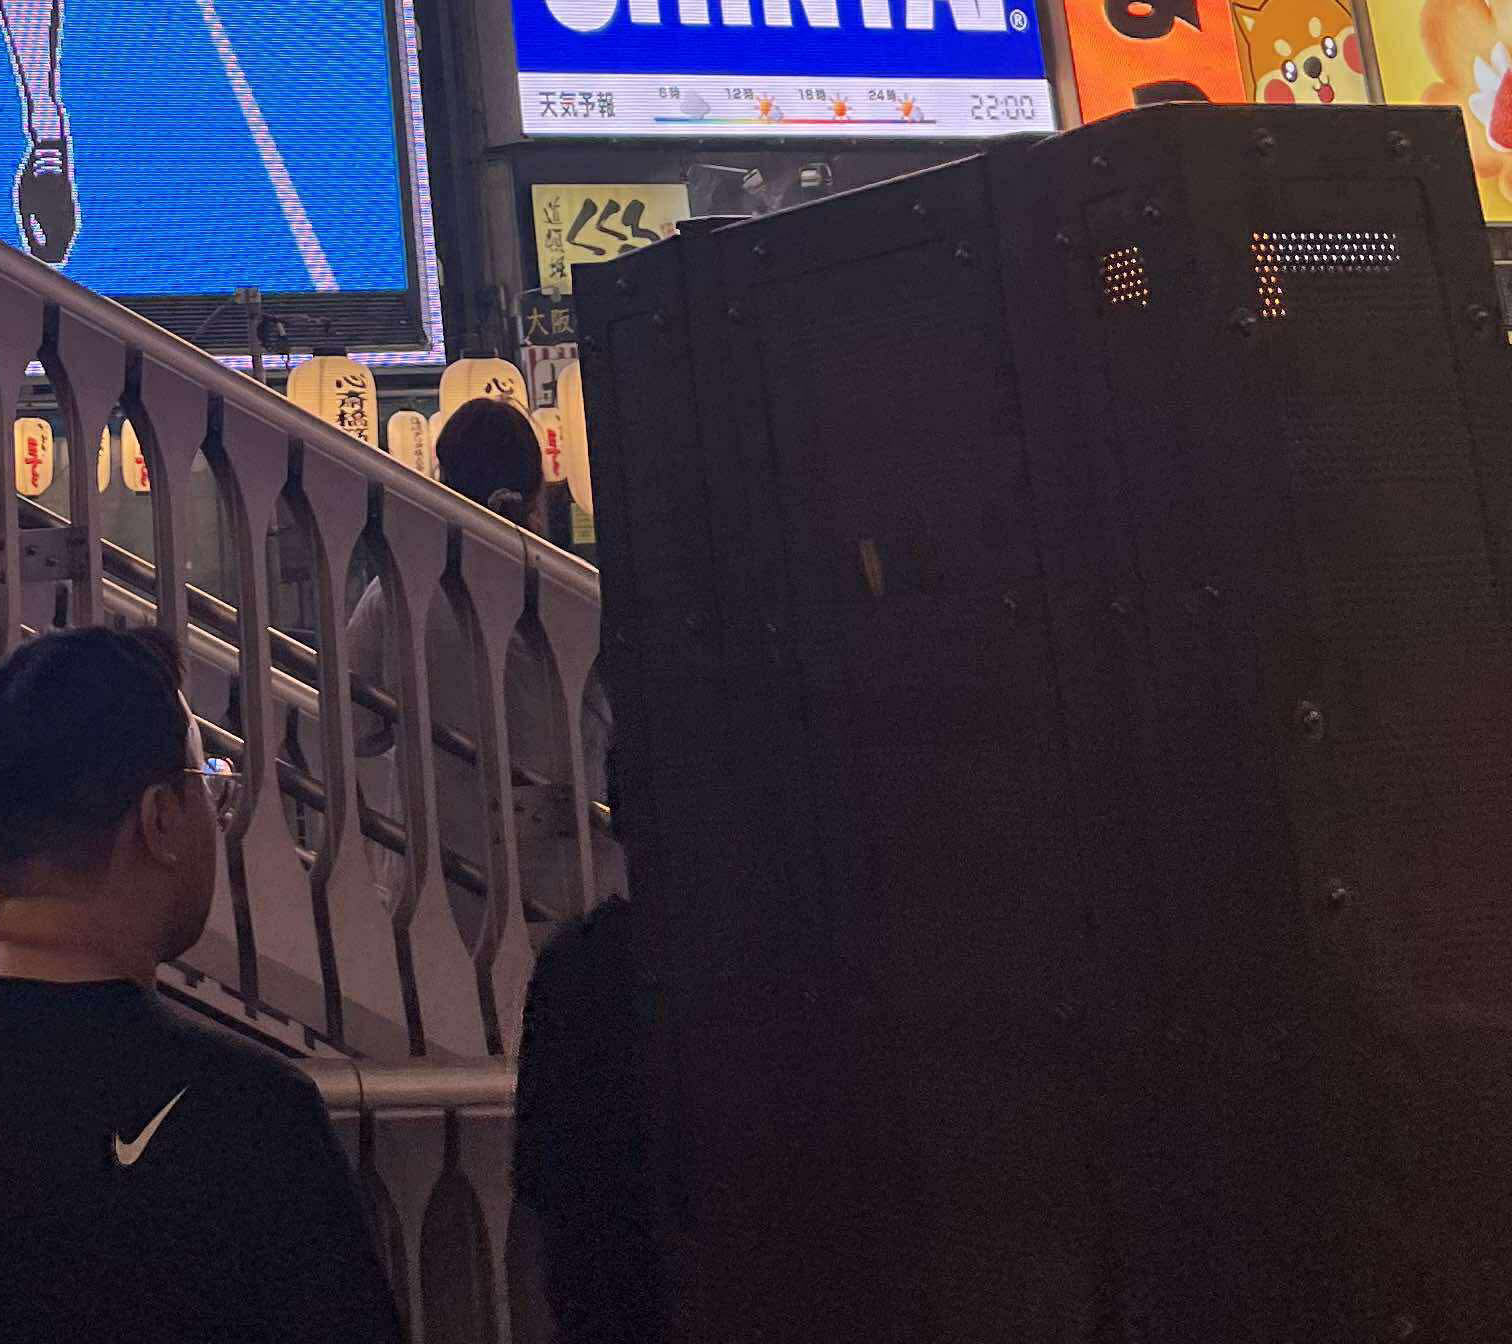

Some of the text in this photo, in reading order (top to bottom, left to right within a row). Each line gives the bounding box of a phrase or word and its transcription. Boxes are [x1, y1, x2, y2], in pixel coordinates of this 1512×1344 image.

[538, 91, 616, 118] 天気予報
[970, 94, 1035, 121] 22:00
